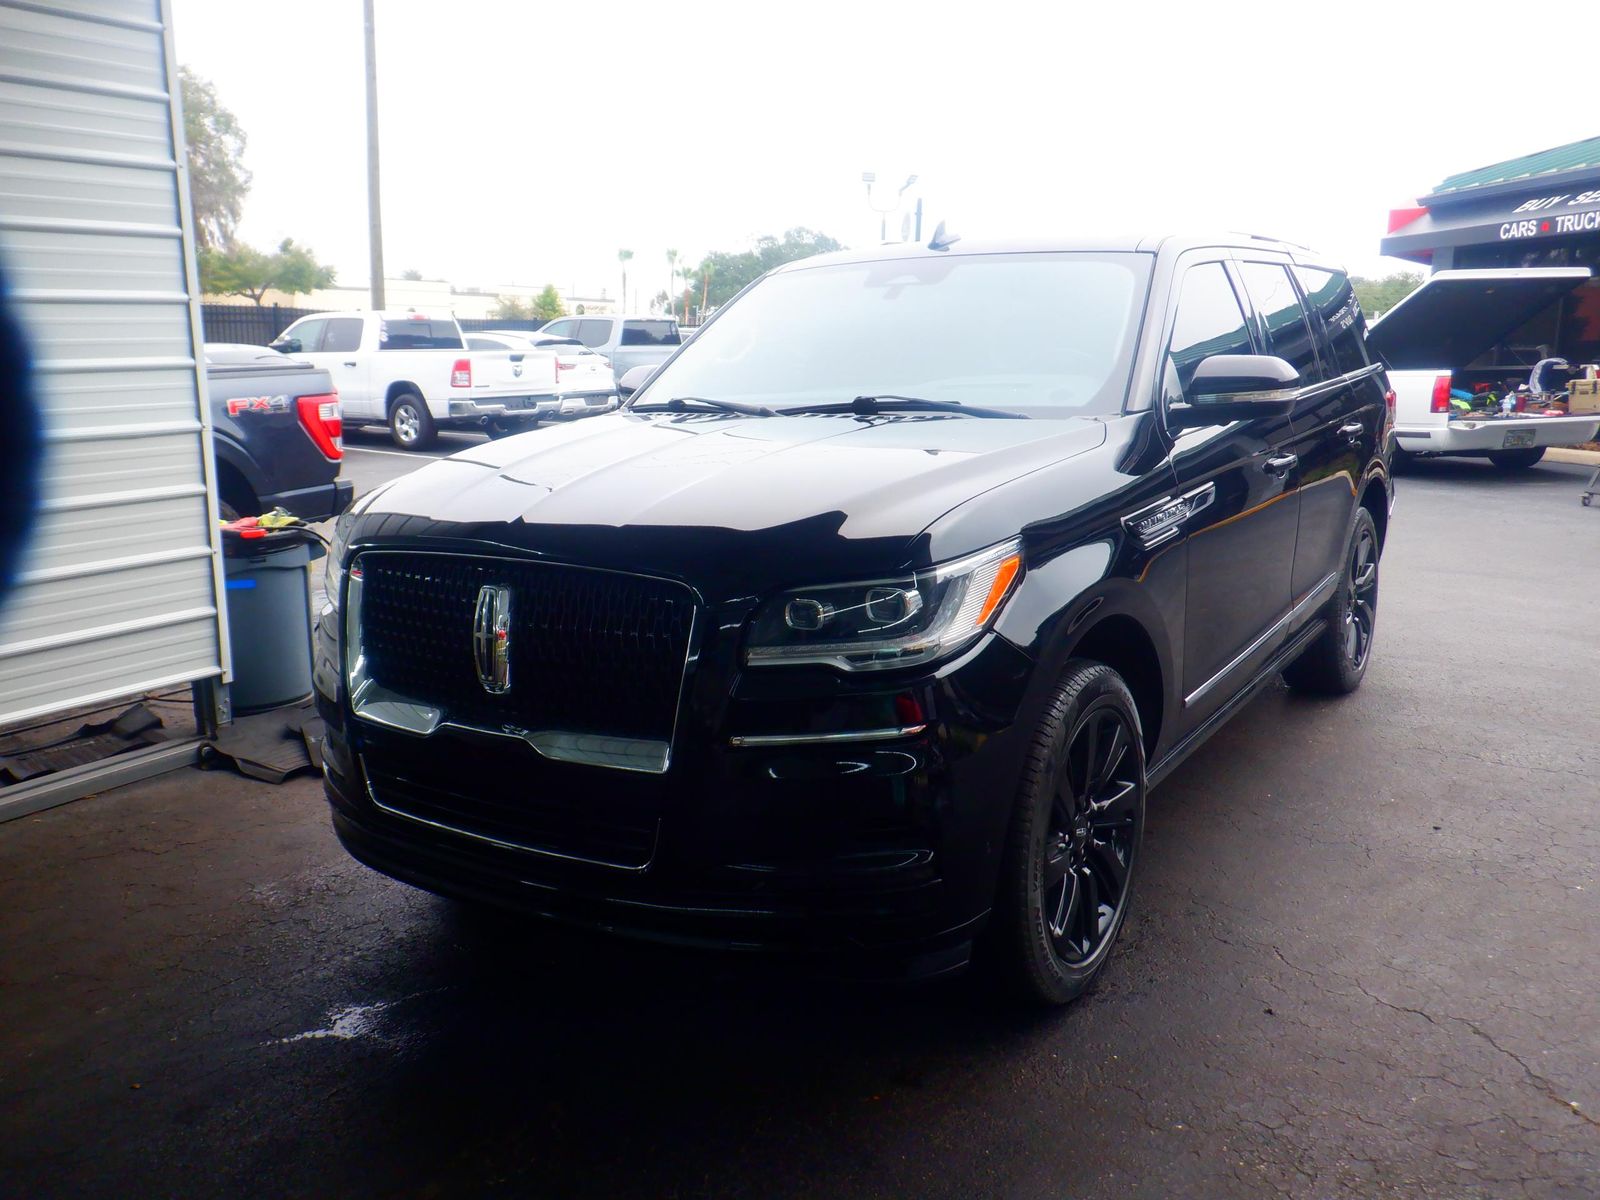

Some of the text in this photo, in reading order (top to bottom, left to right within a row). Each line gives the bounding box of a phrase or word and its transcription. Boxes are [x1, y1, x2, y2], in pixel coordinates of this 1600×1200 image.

[1512, 190, 1600, 214] BUY SE
[1500, 220, 1537, 240] CARS
[226, 394, 291, 417] FX4
